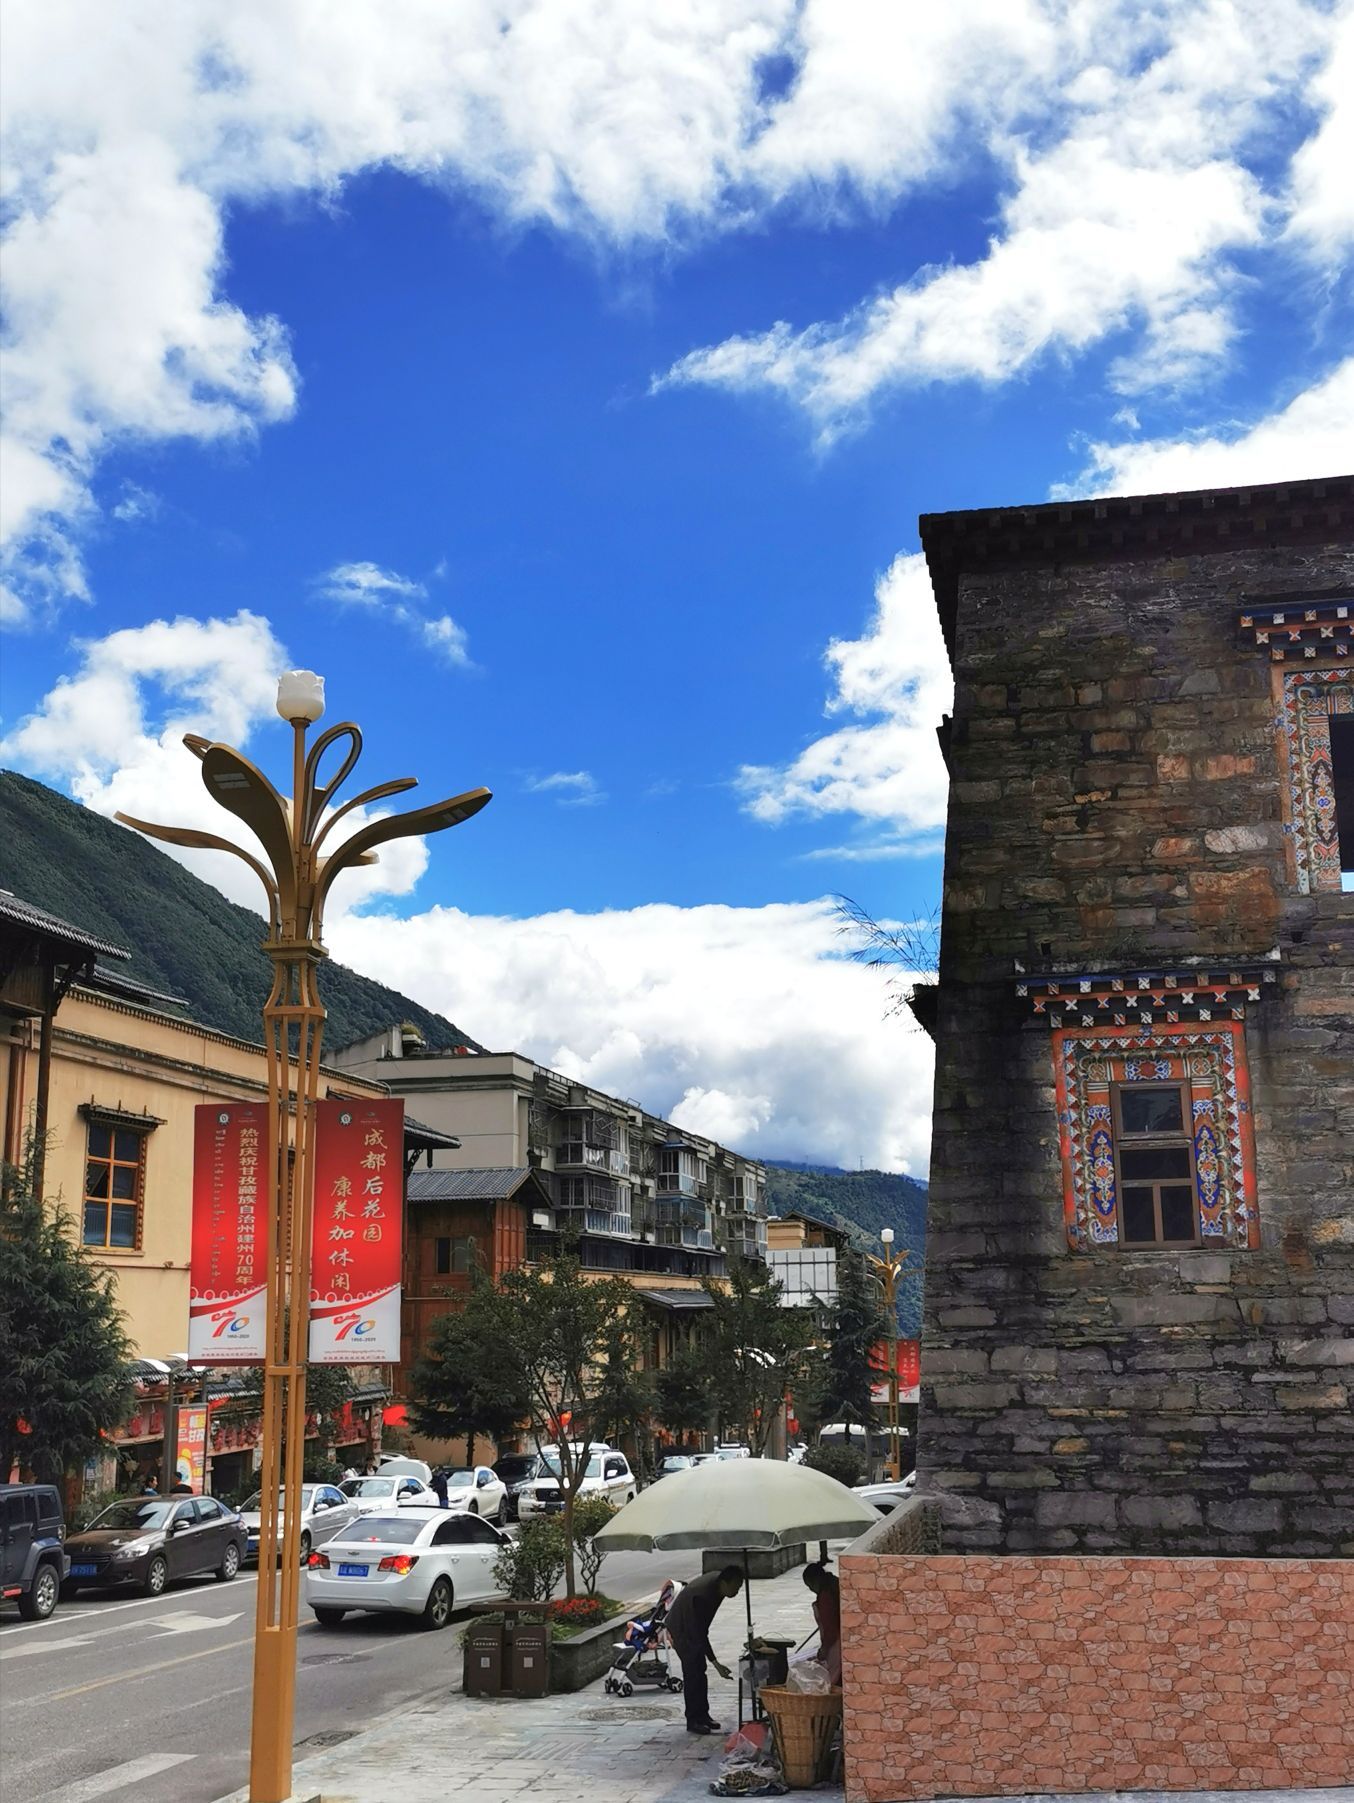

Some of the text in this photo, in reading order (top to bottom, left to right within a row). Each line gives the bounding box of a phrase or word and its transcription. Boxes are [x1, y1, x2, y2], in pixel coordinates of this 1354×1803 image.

[328, 1176, 356, 1291] 康养加休闲
[360, 1128, 388, 1242] 成都后花园
